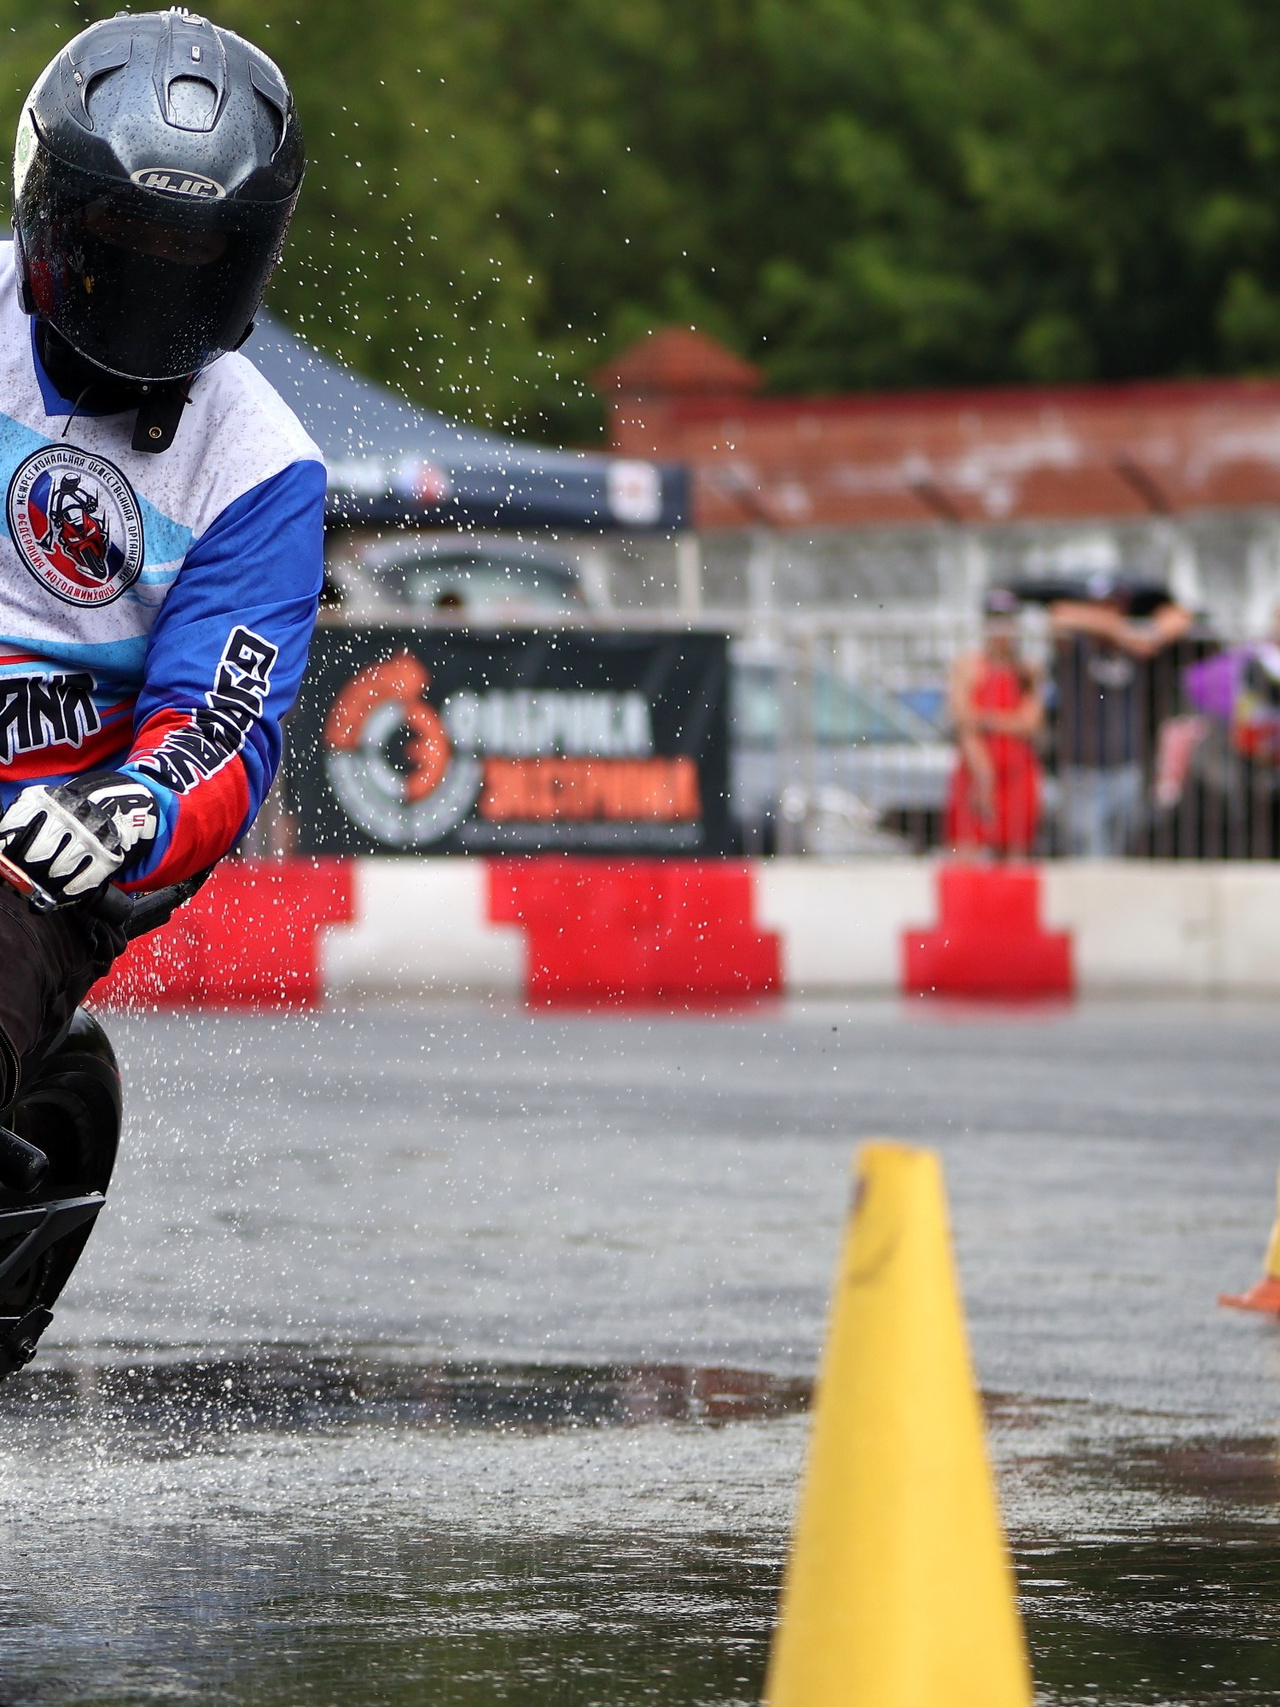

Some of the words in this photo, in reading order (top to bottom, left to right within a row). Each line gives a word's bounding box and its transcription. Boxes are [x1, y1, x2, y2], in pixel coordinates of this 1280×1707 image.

[145, 173, 214, 197] HJC
[16, 453, 86, 506] МЕЖРЕГИОНАЛЬНАЯ
[88, 461, 135, 522] ОБЩЕСТВЕННАЯ
[17, 513, 46, 569] ФЕДЕРАЦИЯ
[44, 570, 116, 601] МОТОДЖИМХАНЫ
